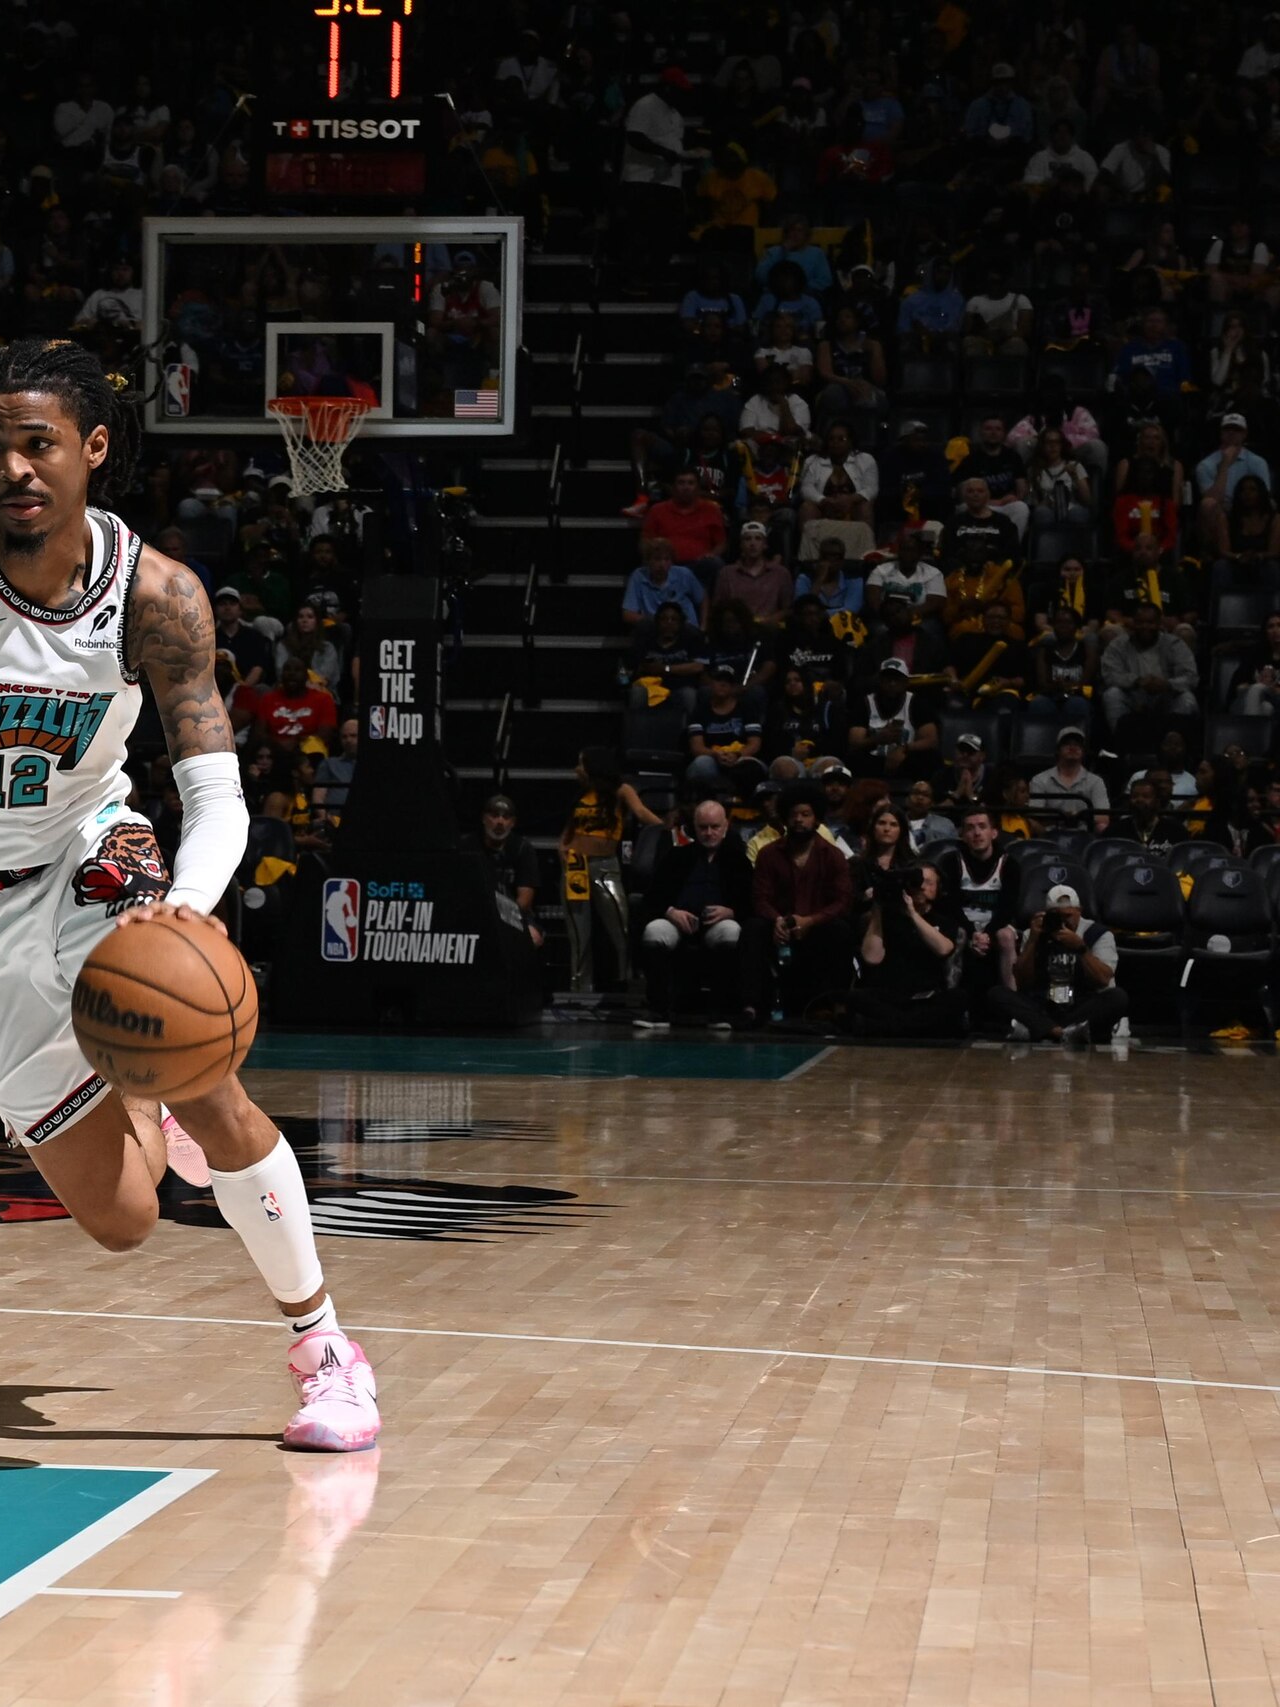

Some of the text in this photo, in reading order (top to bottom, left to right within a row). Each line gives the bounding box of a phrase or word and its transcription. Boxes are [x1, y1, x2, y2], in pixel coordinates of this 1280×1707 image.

[328, 20, 402, 99] 11
[313, 119, 421, 139] TISSOT
[379, 639, 416, 671] GET
[379, 672, 416, 703] THE
[386, 706, 424, 745] App
[366, 881, 405, 899] SoFi
[364, 899, 434, 931] PLAY-IN
[363, 930, 480, 965] TOURNAMENT
